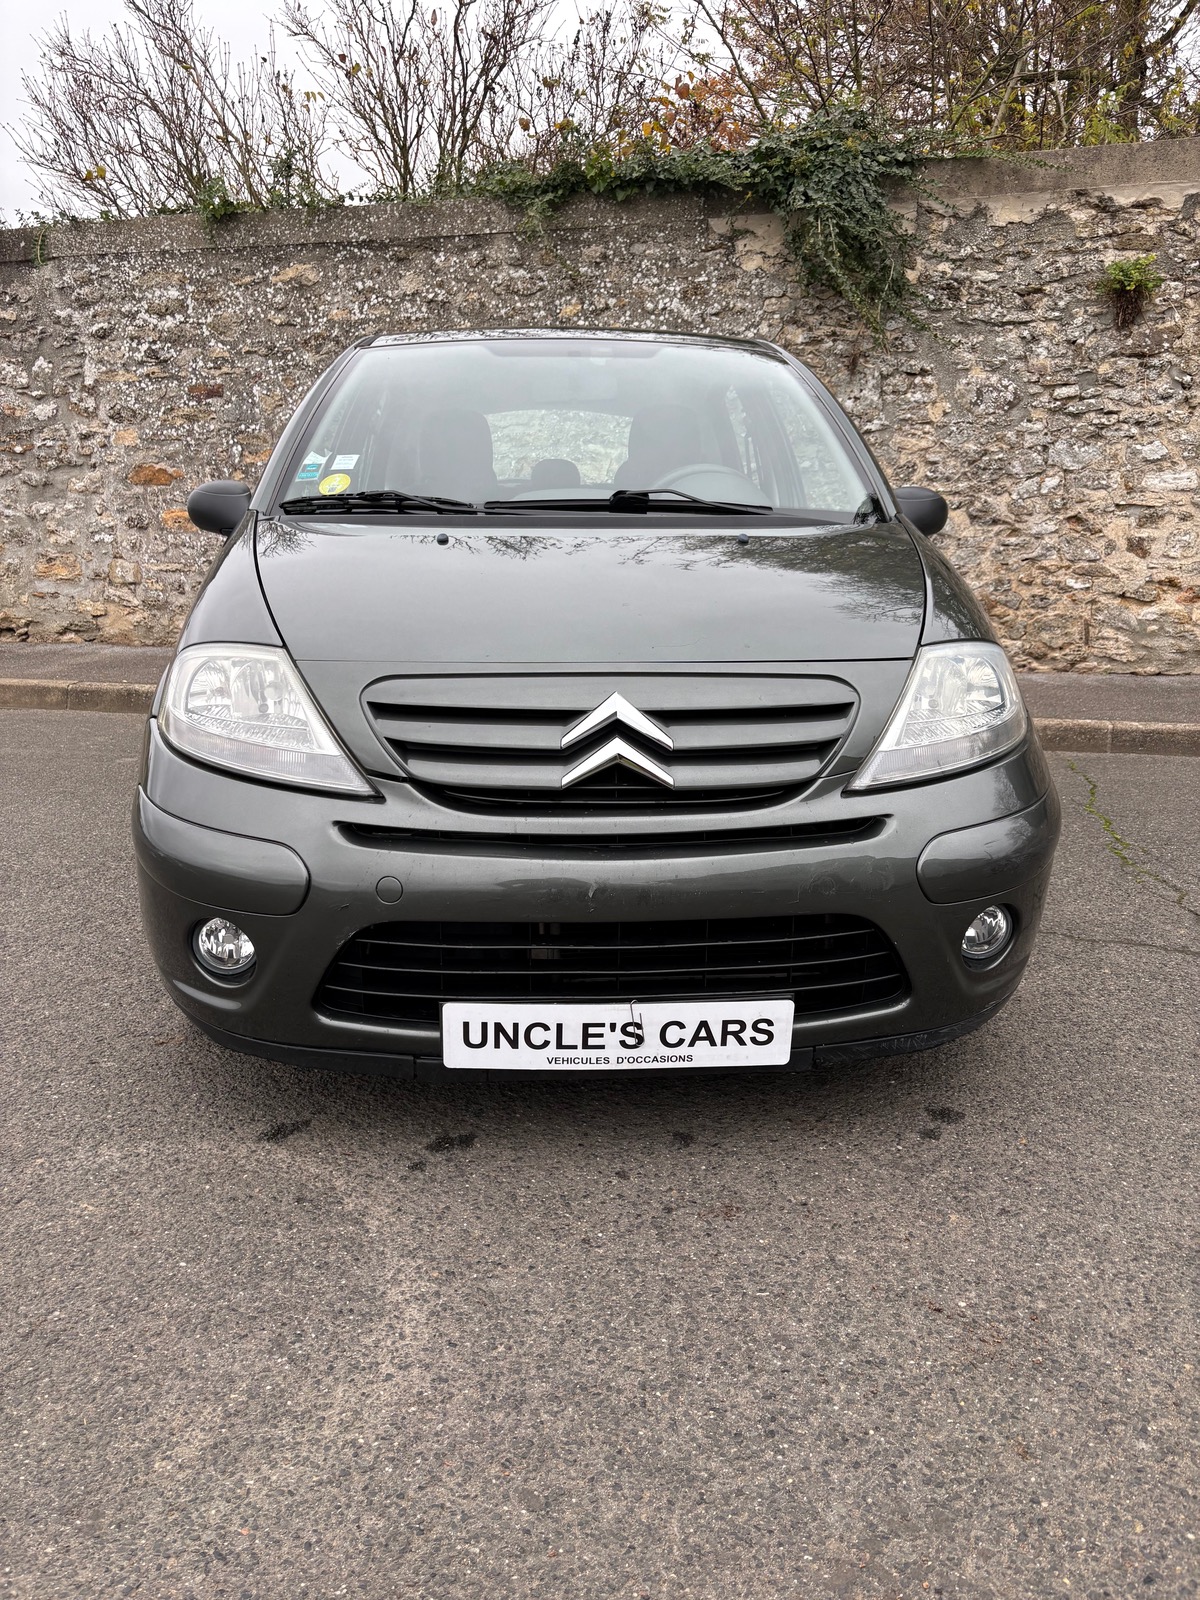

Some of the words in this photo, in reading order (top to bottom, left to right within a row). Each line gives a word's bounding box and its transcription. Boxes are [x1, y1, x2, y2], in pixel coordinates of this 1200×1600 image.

[462, 1021, 644, 1050] UNCLE'S
[659, 1018, 775, 1048] CARS
[546, 1056, 610, 1065] VEHICULES
[616, 1054, 694, 1065] D'OCCASIONS
